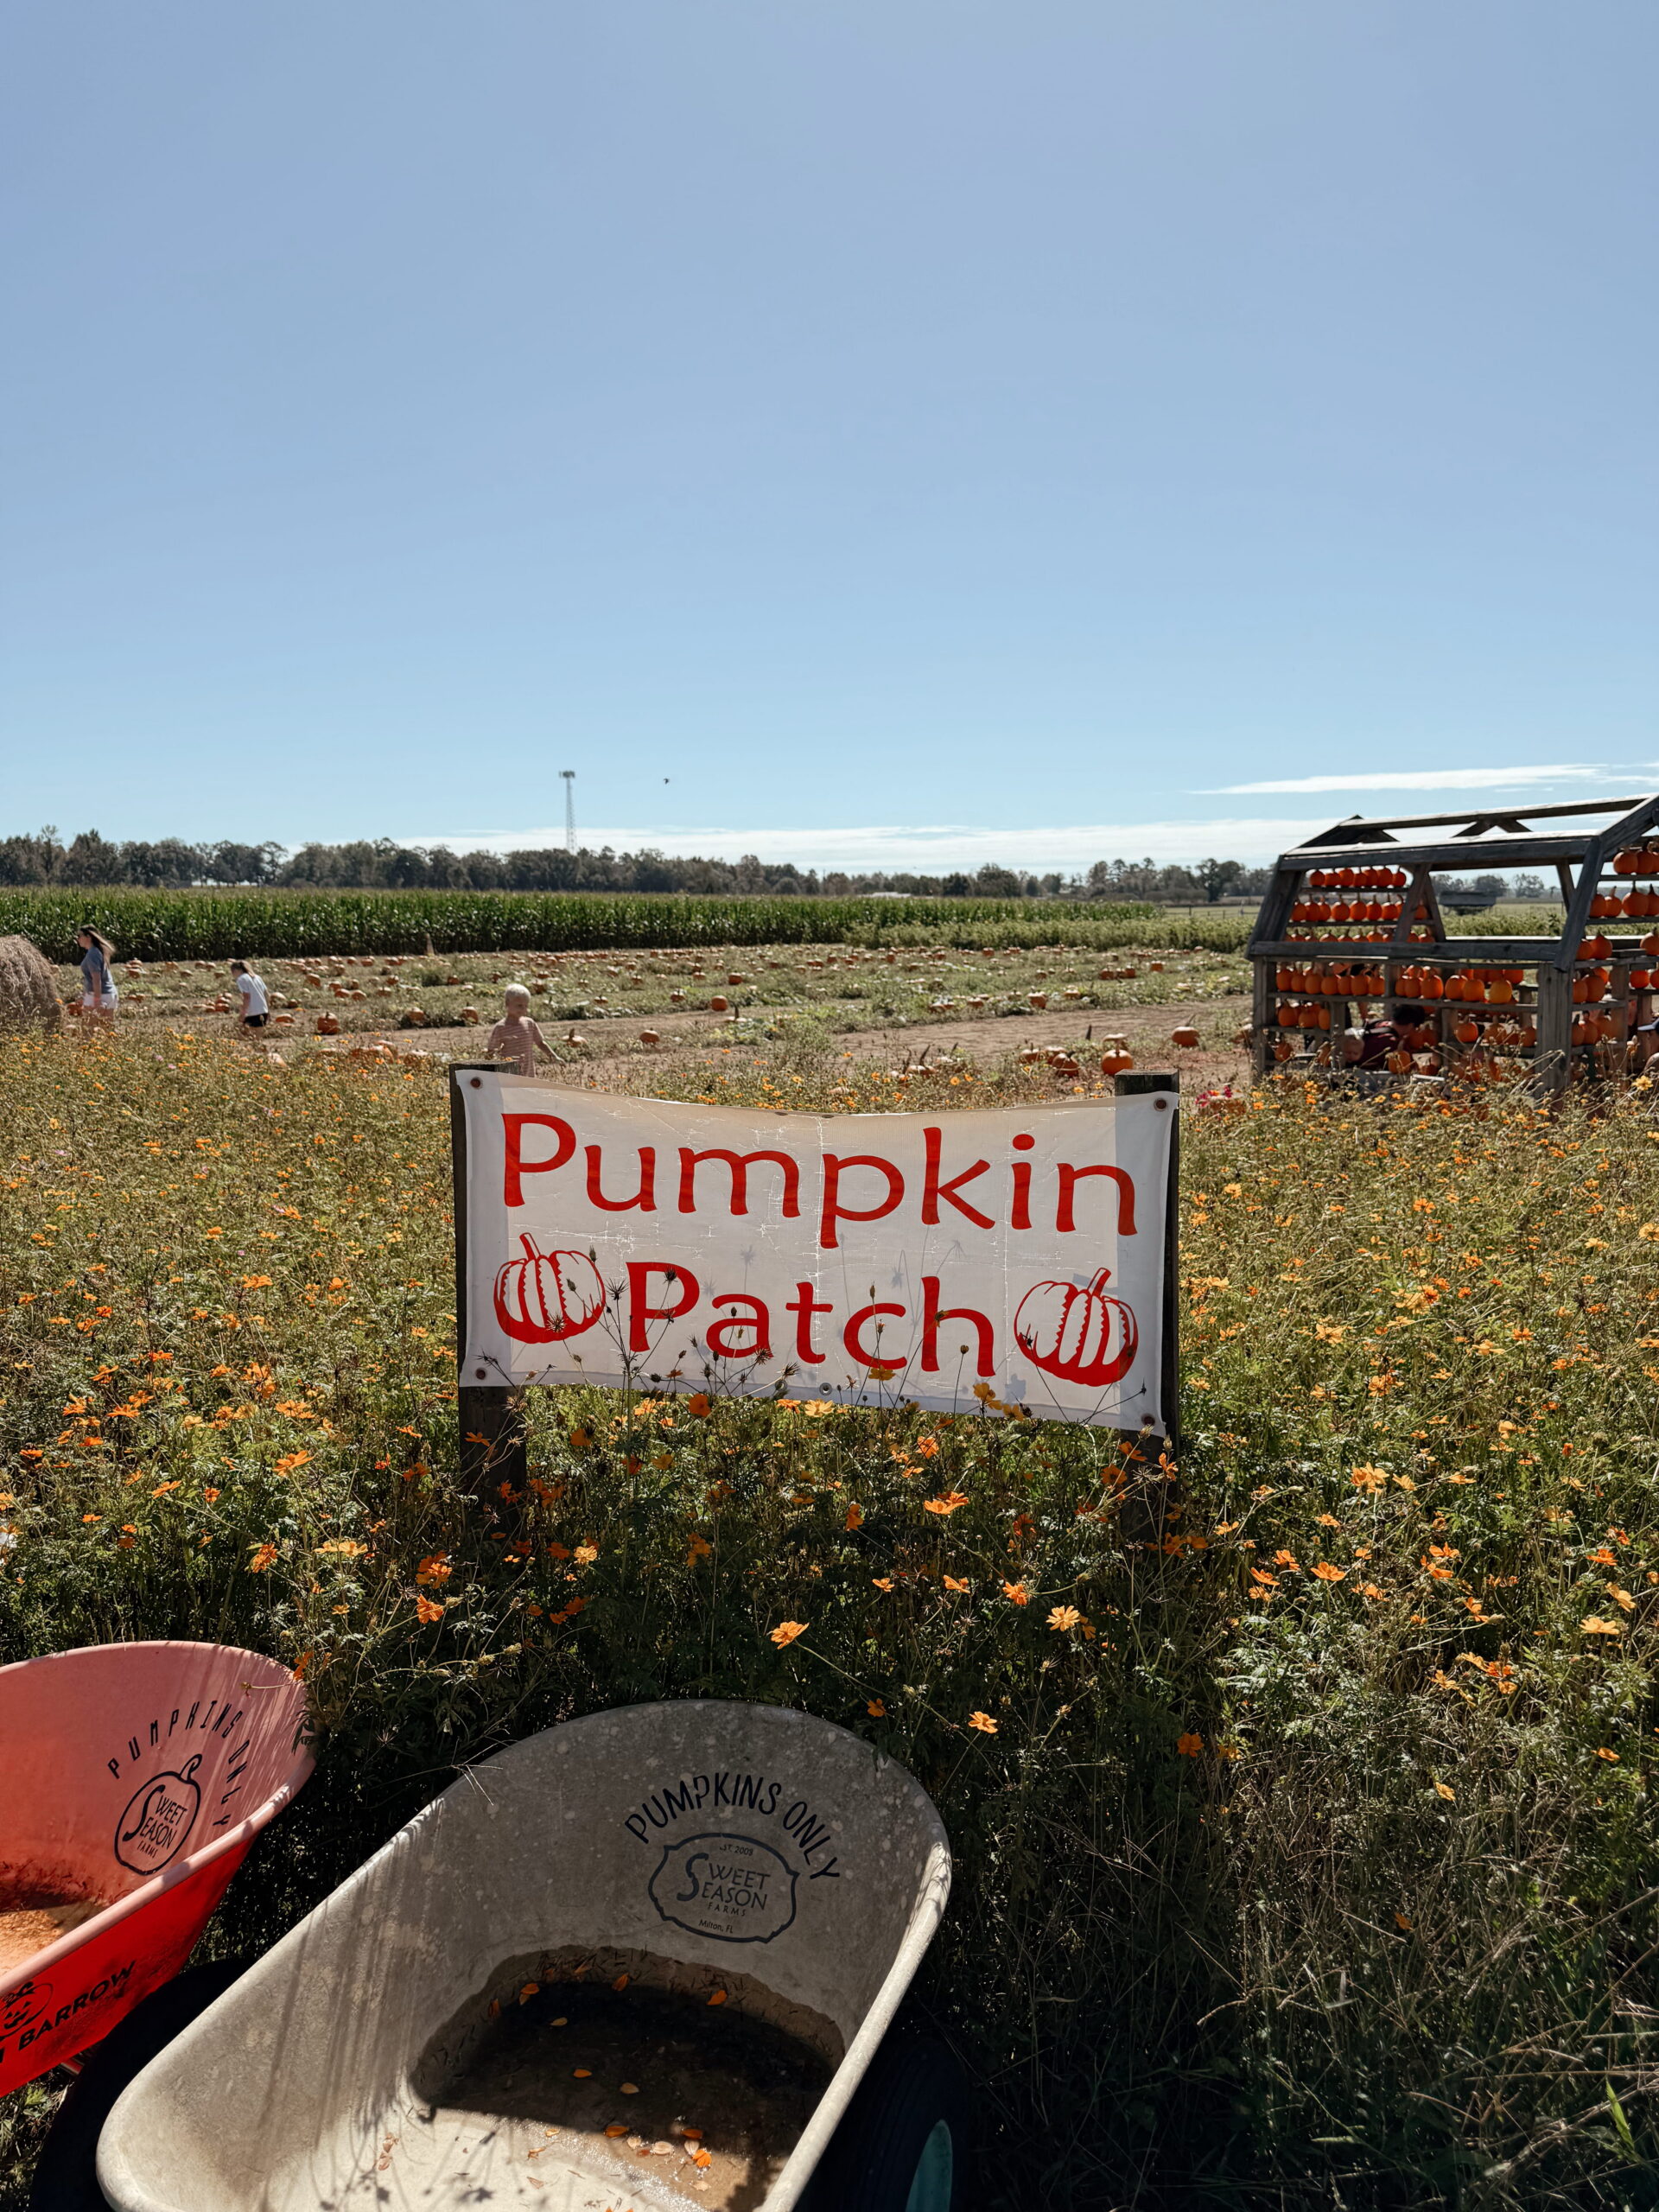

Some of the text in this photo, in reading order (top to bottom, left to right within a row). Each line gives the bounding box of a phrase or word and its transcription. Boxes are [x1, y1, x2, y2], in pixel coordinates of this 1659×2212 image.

[503, 1113, 1137, 1249] Pumpkin
[627, 1262, 996, 1377] Patch
[107, 1700, 251, 1827] PUMPKINS ONLY
[137, 1840, 158, 1859] FARMS
[624, 1771, 840, 1880] PUMPKINS ONLY
[698, 1918, 734, 1934] Milton, FL
[708, 1902, 747, 1917] FARMS
[17, 1960, 136, 2050] BARROW
